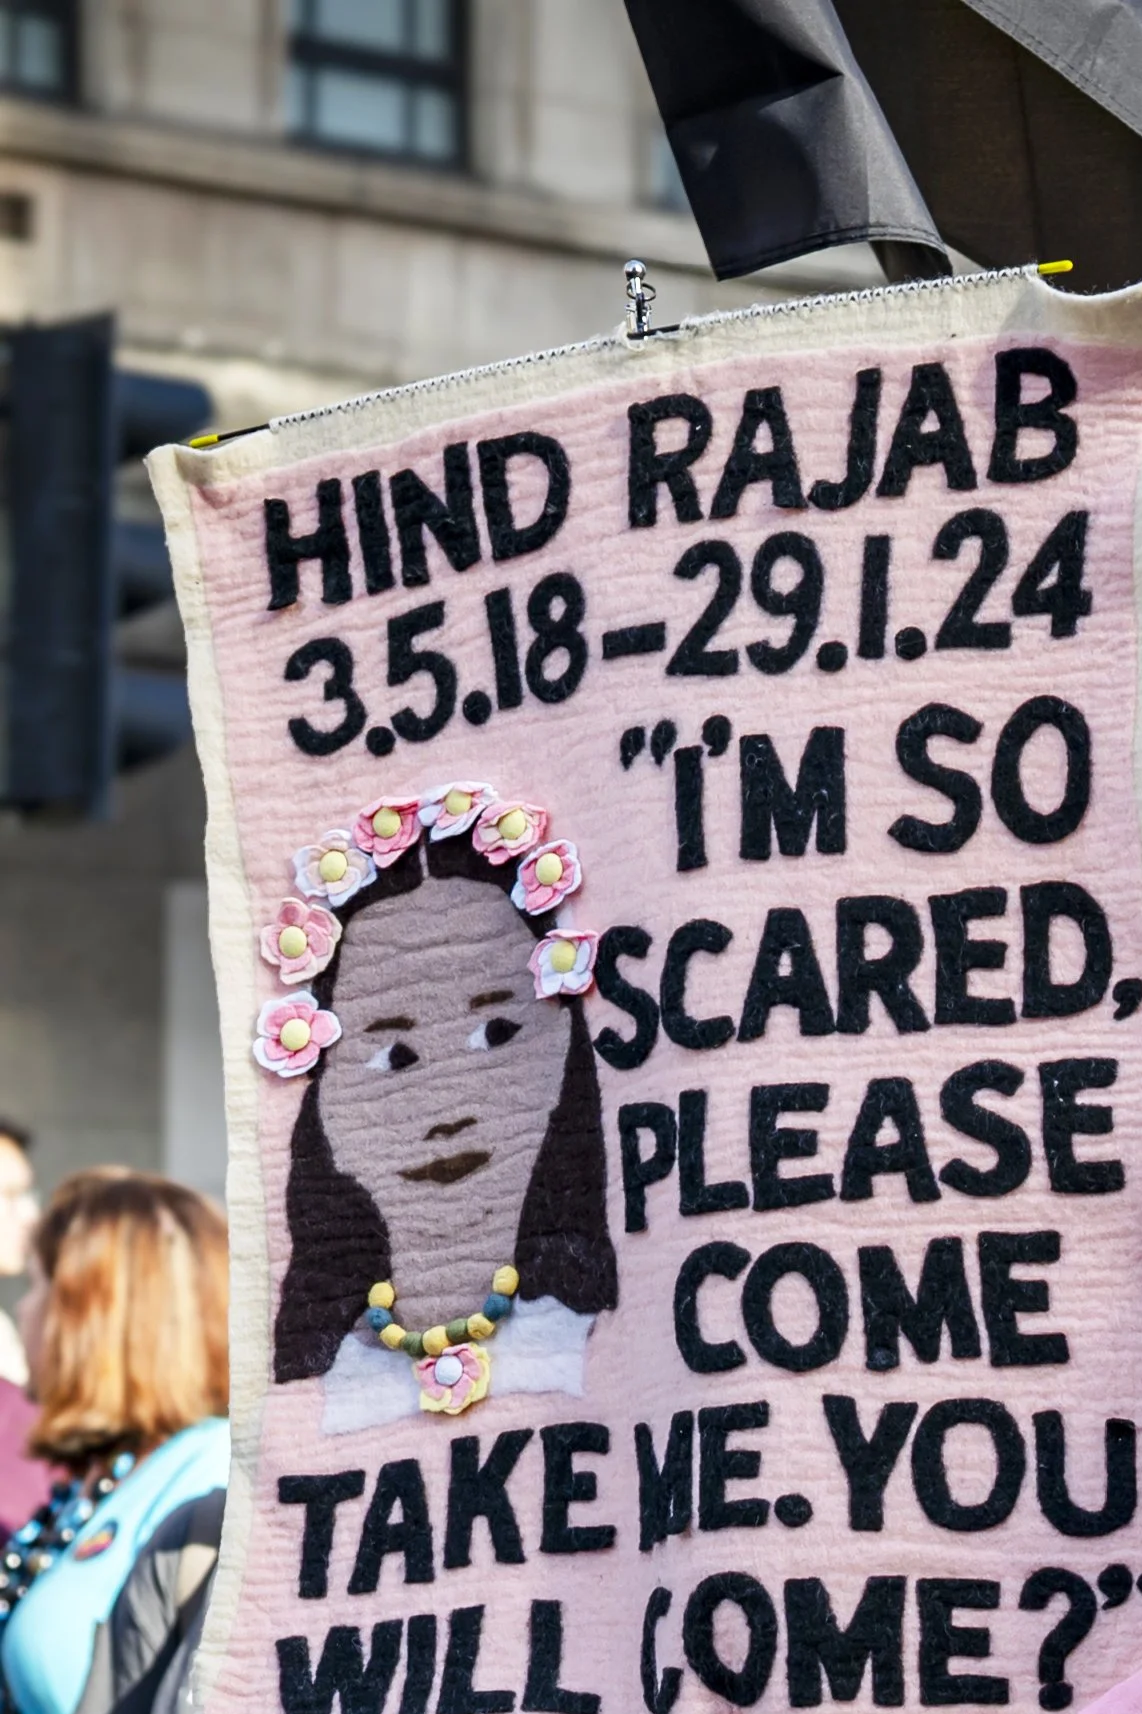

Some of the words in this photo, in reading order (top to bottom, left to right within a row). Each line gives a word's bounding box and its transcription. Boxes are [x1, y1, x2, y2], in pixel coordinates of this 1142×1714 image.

[264, 431, 570, 612] HIND
[627, 347, 1079, 529] RAJAB
[886, 695, 1092, 854] SO
[618, 1057, 1126, 1234] PLEASE
[673, 1230, 1070, 1375] COME
[277, 1421, 617, 1600] TAKE
